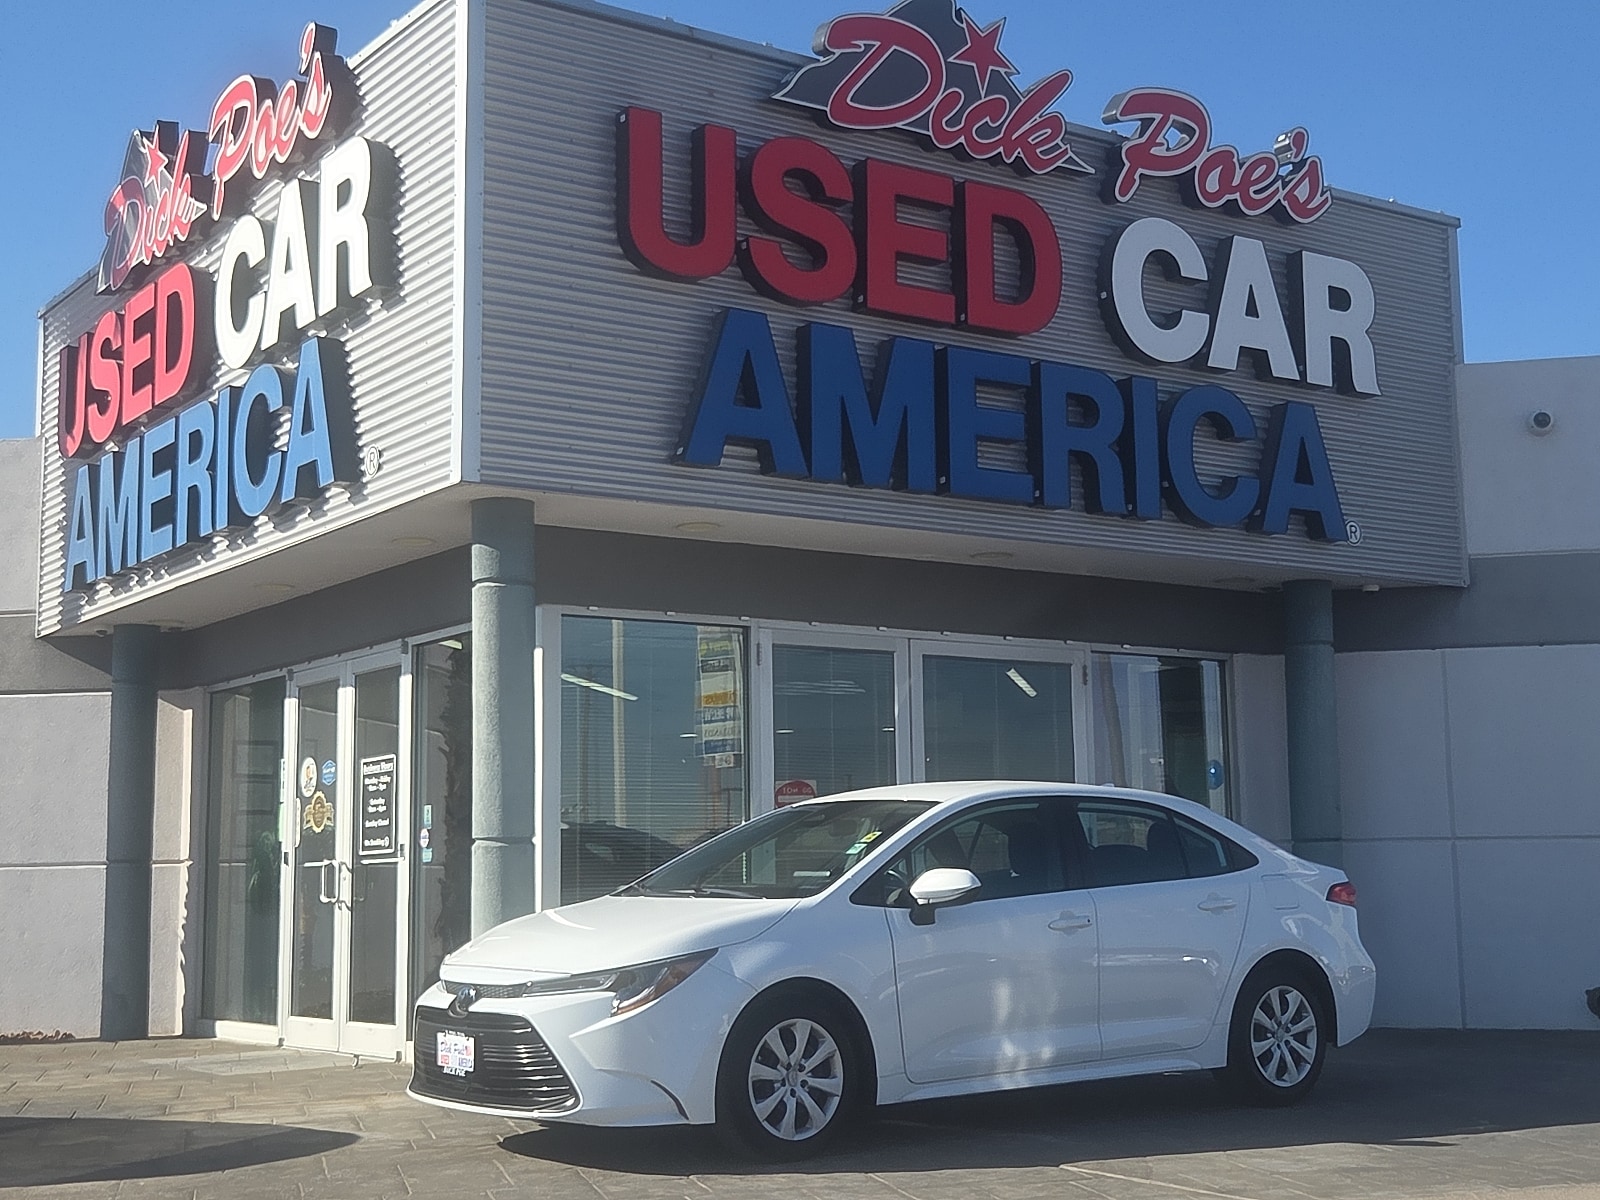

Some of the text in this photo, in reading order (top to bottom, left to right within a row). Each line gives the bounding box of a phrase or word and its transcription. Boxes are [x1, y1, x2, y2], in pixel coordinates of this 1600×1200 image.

[104, 22, 332, 290] Dick Poe's
[826, 15, 1333, 223] Dick Poe's
[60, 137, 373, 457] USED CAR
[625, 106, 1382, 395] USED CAR
[65, 336, 334, 592] AMERICA
[683, 308, 1348, 542] AMERICA
